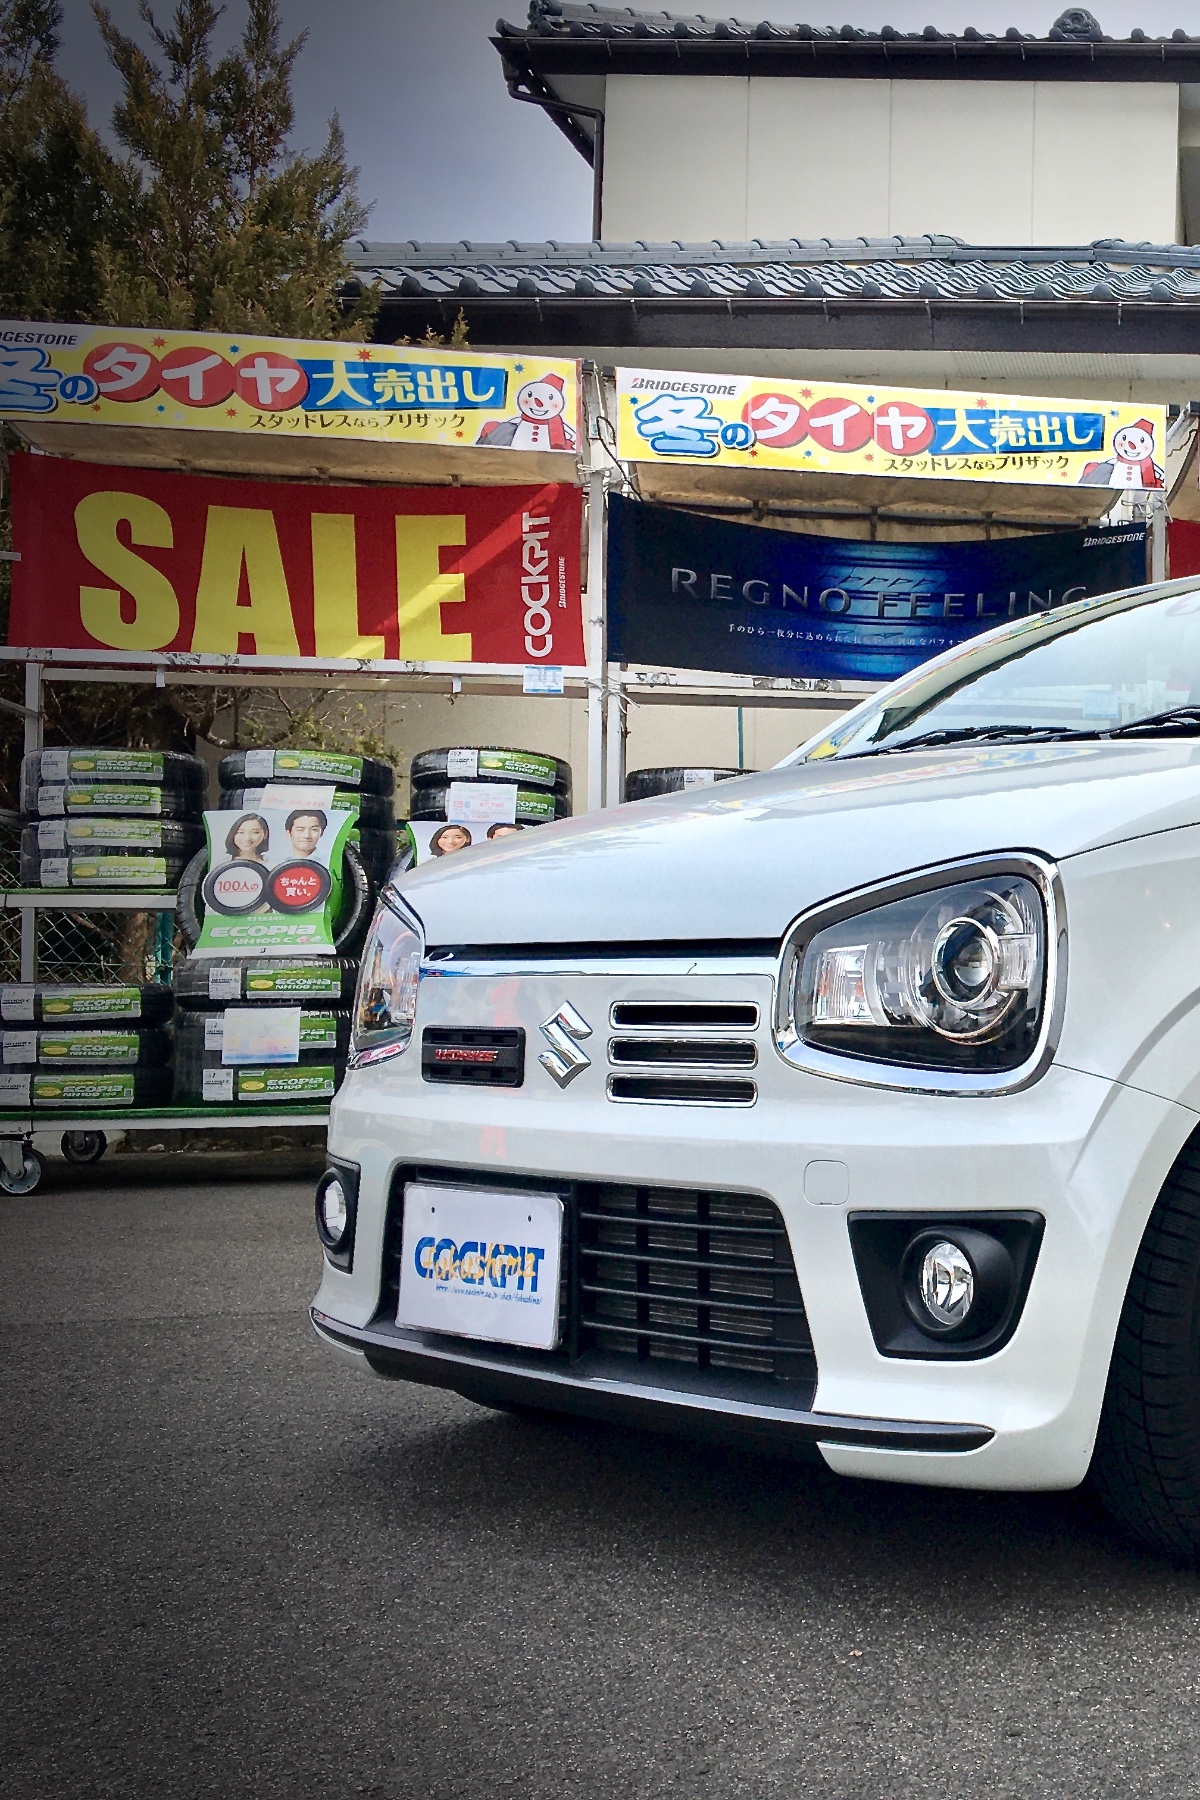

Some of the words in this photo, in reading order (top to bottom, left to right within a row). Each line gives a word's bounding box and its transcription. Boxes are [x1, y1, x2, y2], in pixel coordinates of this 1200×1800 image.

[0, 331, 78, 346] GESTONE
[631, 378, 737, 396] BRIDGESTONE
[249, 412, 466, 430] スタッドレスならブリザック
[884, 456, 1069, 471] スタッドレスならブリザック
[1083, 533, 1145, 547] BRIDGESTONE
[74, 491, 472, 661] SALE
[521, 512, 552, 657] COCKPIT
[672, 568, 851, 615] REGNO
[217, 880, 259, 891] 100人の
[280, 877, 317, 887] ちゃんと
[414, 1236, 545, 1293] COCKPIT
